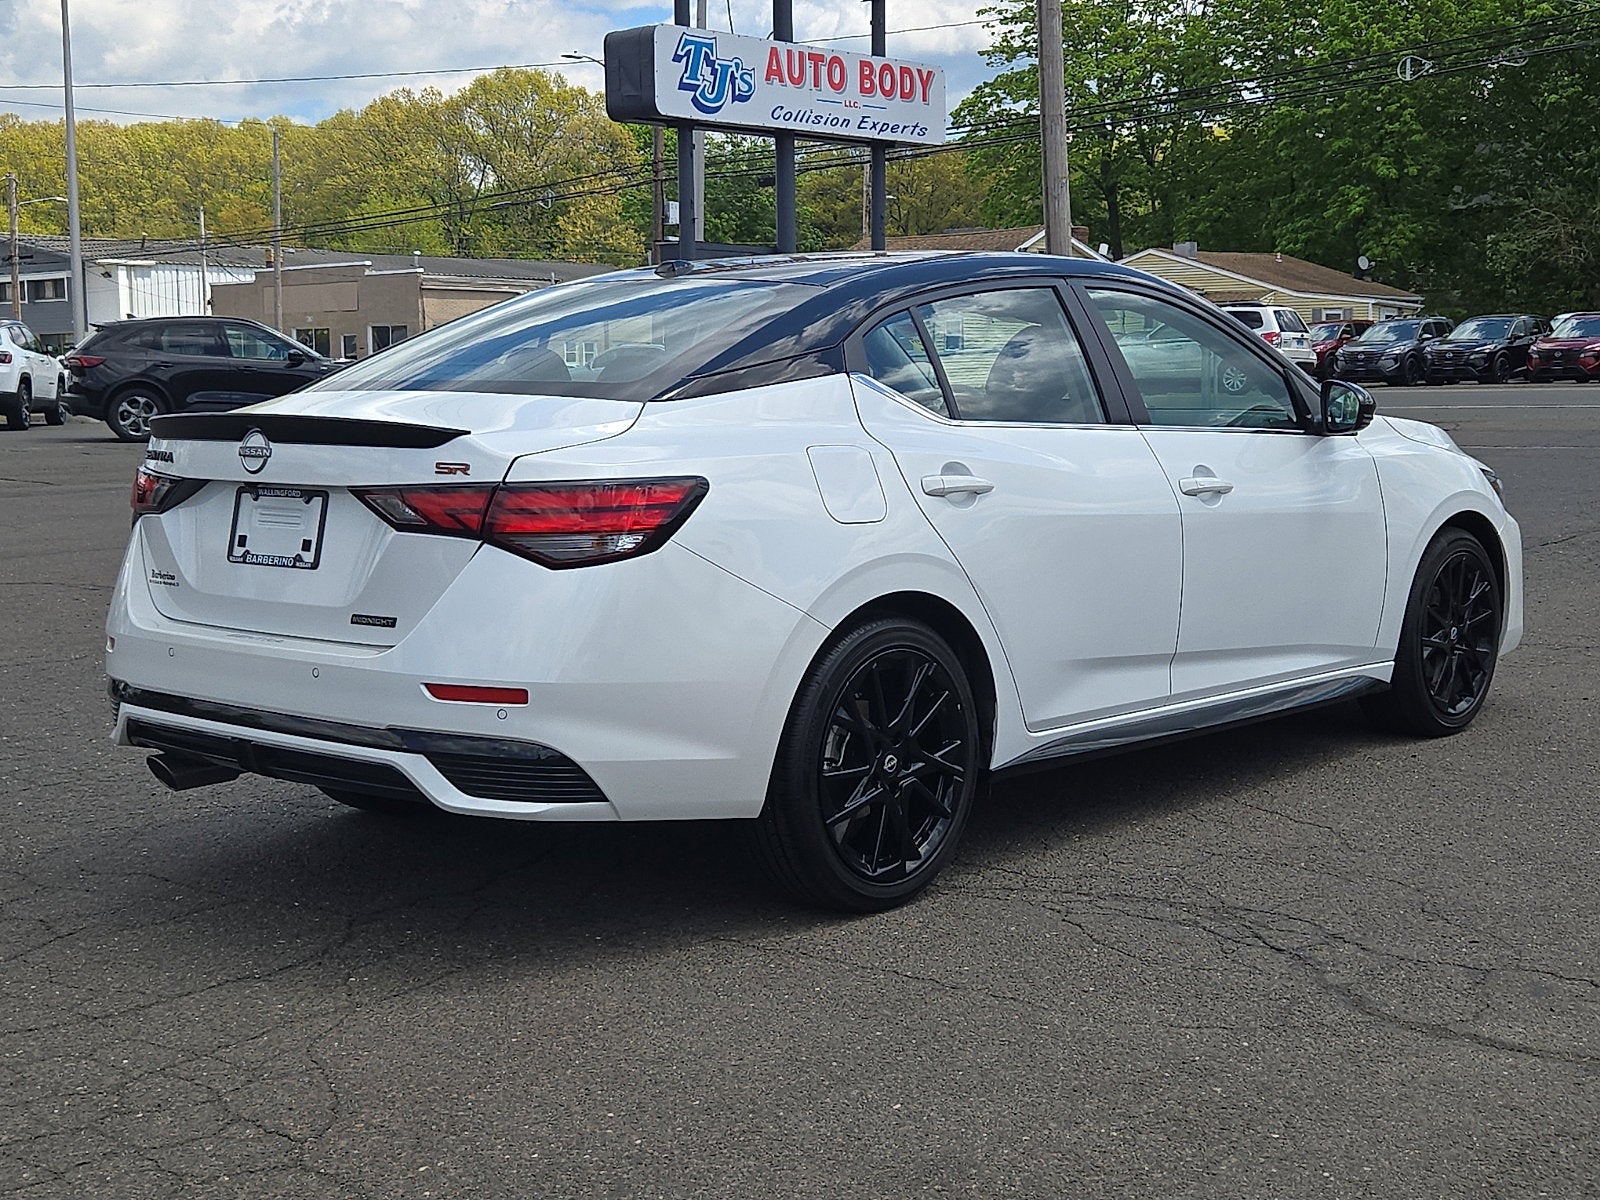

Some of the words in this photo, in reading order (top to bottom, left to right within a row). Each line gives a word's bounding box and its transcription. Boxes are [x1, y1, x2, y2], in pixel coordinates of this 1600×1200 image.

[764, 46, 847, 93] AUTO
[858, 59, 936, 105] BODY
[770, 104, 851, 129] Collision
[857, 115, 929, 138] Experts
[434, 462, 471, 476] SR
[245, 553, 295, 568] BARBERINO
[351, 615, 394, 626] MIDNIGHT
